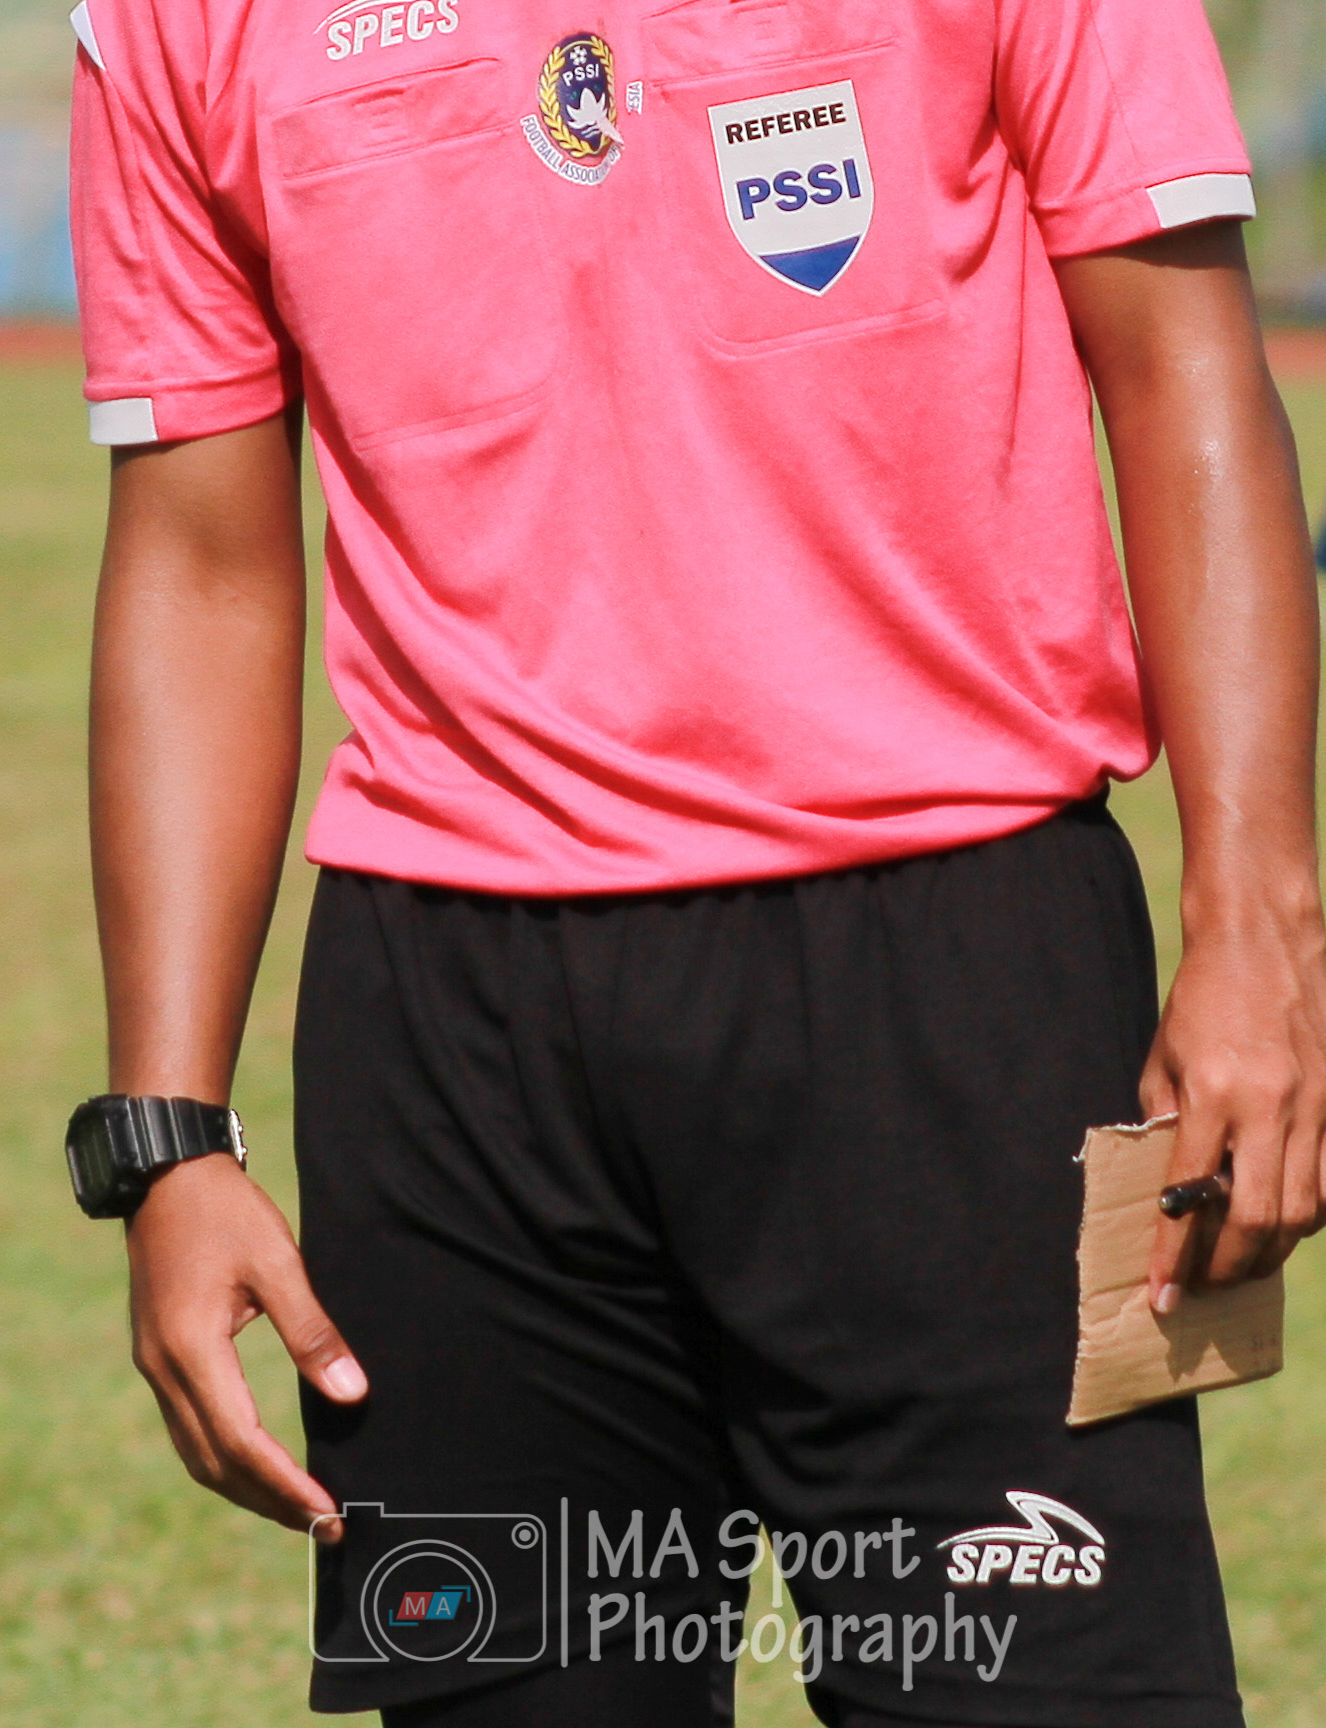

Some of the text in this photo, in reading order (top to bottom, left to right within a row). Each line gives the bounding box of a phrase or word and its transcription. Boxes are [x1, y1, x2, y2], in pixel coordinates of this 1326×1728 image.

[562, 63, 600, 87] PSSI
[523, 116, 563, 170] FOOTBALL
[725, 102, 847, 145] REFEREE
[736, 158, 862, 221] PSSI
[946, 1542, 1106, 1586] SPECS
